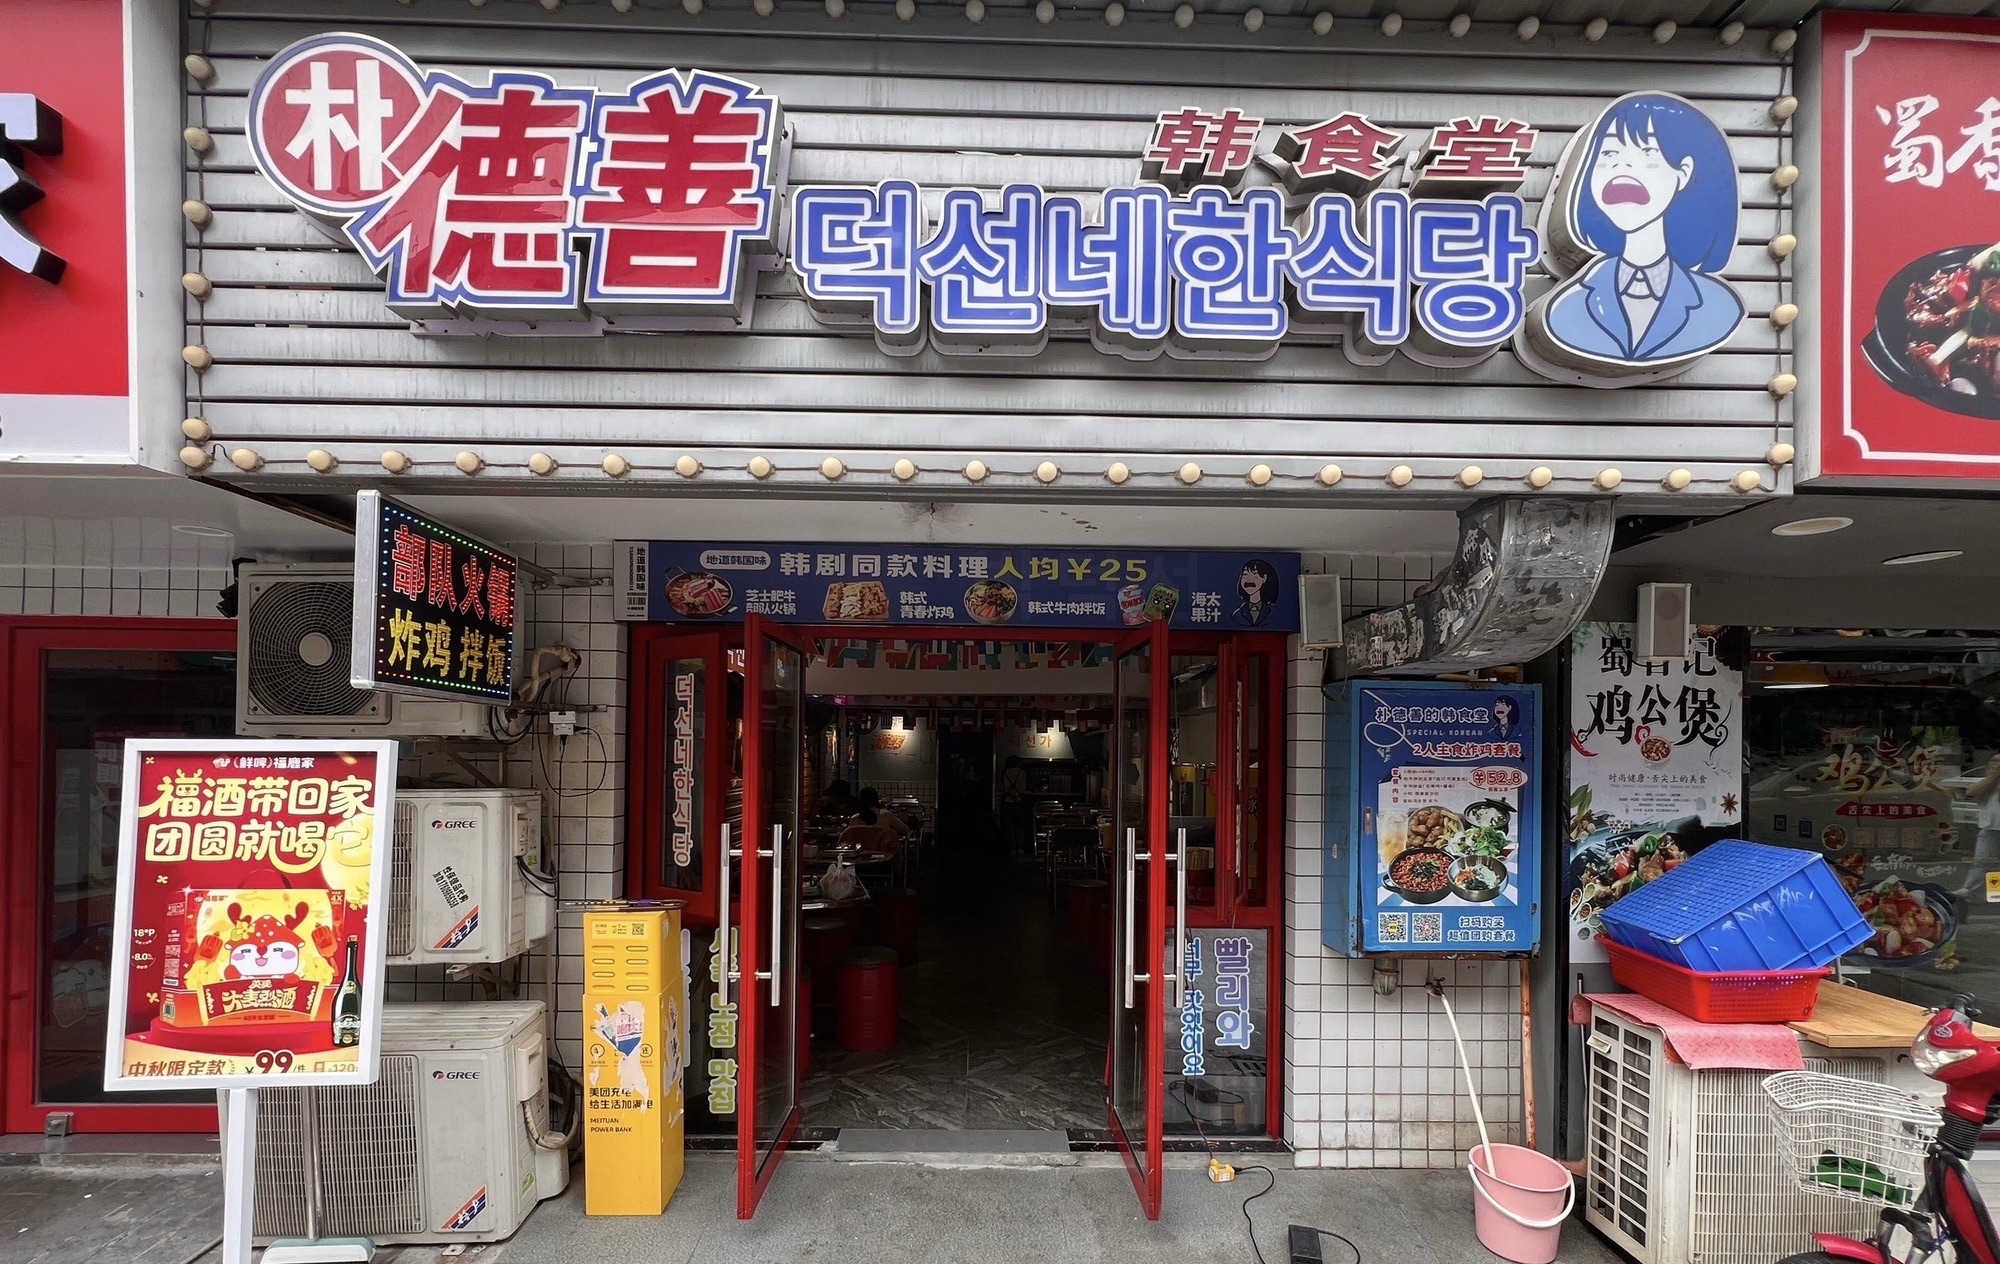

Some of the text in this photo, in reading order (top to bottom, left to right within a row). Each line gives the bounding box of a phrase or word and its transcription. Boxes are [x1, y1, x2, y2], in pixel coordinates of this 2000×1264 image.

[1144, 108, 1540, 190] 韩食堂
[270, 52, 768, 298] 朴德善
[796, 180, 1536, 346] 덕선네한식당
[705, 554, 767, 567] 地道韩国味
[745, 589, 796, 602] 芝士肥牛
[899, 591, 927, 605] 韩式
[1191, 591, 1221, 607] 海太
[745, 602, 796, 615] 部队火锅
[899, 605, 954, 619] 青春炸鸡
[1027, 601, 1106, 617] 韩式牛肉拌饭
[1191, 607, 1221, 623] 果汁
[1375, 706, 1490, 724] 朴德善的韩食堂
[1586, 683, 1722, 749] 鸡公煲
[1449, 729, 1483, 737] KOREAN
[1412, 741, 1522, 758] 2人主食炸鸡套餐
[672, 672, 694, 867] 덕선네한식당
[1472, 769, 1523, 786] ¥52.8
[140, 769, 374, 818] 福酒带回家
[1847, 803, 1928, 817] 舌尖上的美食
[444, 820, 478, 829] GREE
[1459, 916, 1505, 928] 扫码购买
[1447, 929, 1516, 941] 超值团购套餐
[1214, 937, 1254, 1050] 빨리와
[128, 1060, 226, 1077] 中秋限定款
[446, 1072, 481, 1080] GREE
[708, 1058, 738, 1114] 맛집
